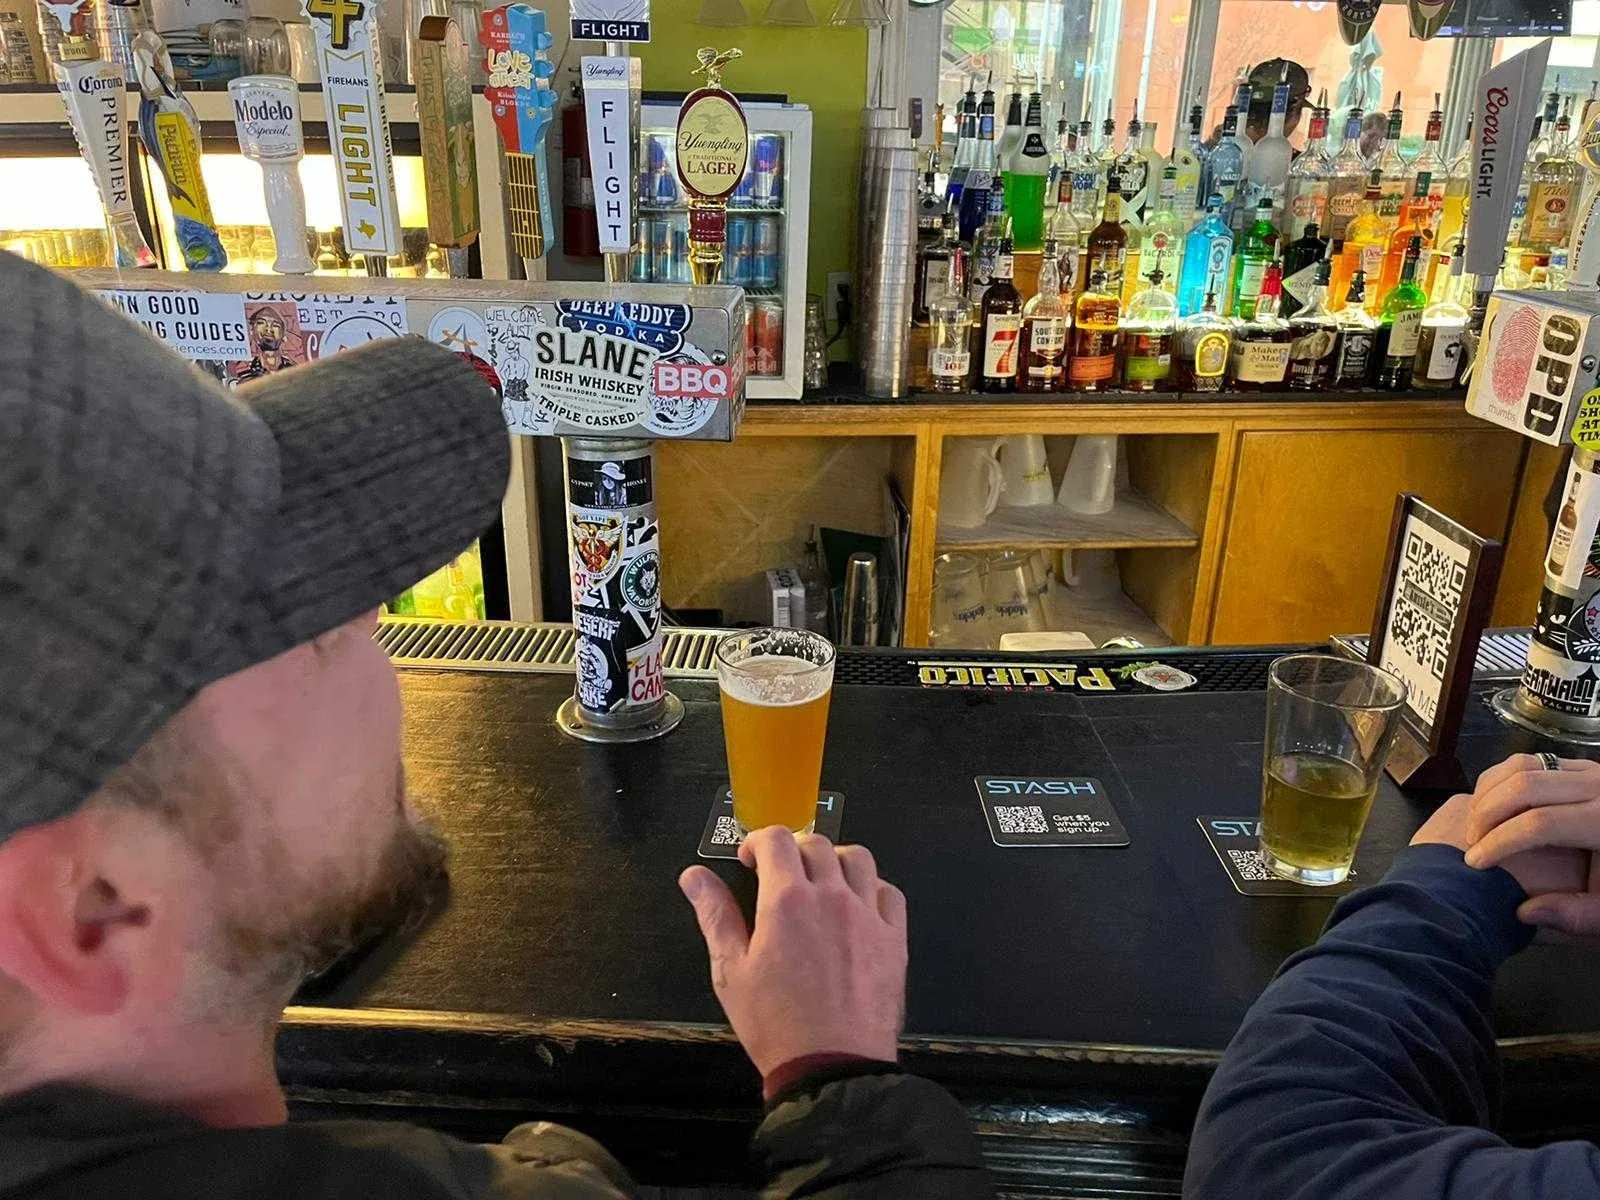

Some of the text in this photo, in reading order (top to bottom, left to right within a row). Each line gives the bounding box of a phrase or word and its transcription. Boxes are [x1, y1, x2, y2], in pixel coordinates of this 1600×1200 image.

[581, 23, 641, 38] FLIGHT
[327, 76, 369, 87] FIREMANS
[586, 63, 625, 77] Yuengling
[78, 75, 123, 95] Corona
[234, 99, 294, 121] Modelo
[1482, 87, 1509, 147] Coors
[101, 97, 128, 204] PREMIER
[678, 130, 745, 155] Yuengling
[337, 103, 377, 208] LIGHT
[601, 100, 622, 243] FLIGHT
[686, 161, 737, 176] LAGER
[148, 295, 200, 315] GOOD
[570, 300, 675, 326] DEEP EDDY
[175, 321, 246, 342] GUIDES
[578, 319, 665, 344] VODKA
[535, 331, 647, 381] SLANE
[991, 329, 1018, 374] 7
[535, 367, 646, 397] IRISH WHISKEY
[658, 366, 728, 397] BBQ
[538, 395, 581, 423] TRIPLE
[585, 412, 636, 427] CASKED
[918, 667, 1117, 691] PACIFICO
[1418, 689, 1438, 720] ME
[985, 779, 1097, 796] STASH
[1057, 826, 1103, 834] sign up.
[1088, 821, 1110, 829] you
